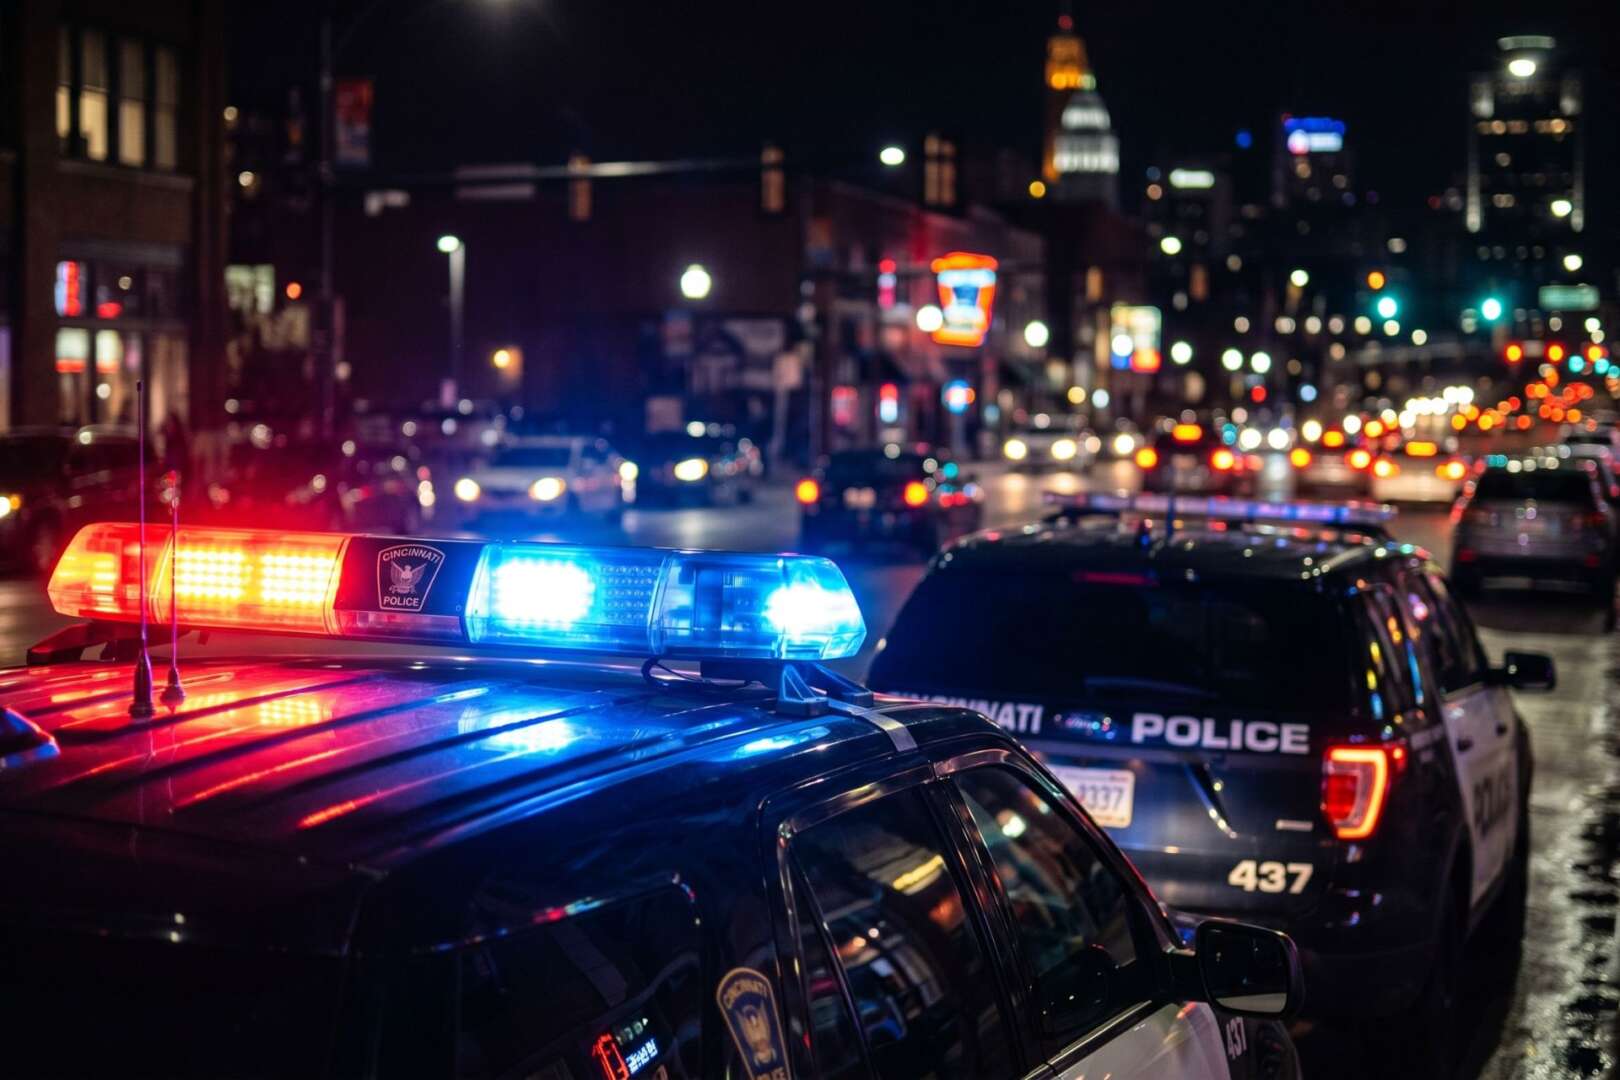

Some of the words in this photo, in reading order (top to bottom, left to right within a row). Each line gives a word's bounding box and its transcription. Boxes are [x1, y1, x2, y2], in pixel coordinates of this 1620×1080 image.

[382, 548, 440, 563] CINCINNATI
[383, 596, 419, 606] POLICE
[1131, 712, 1310, 754] POLICE
[1227, 858, 1314, 894] 437
[1225, 1016, 1247, 1060] 437
